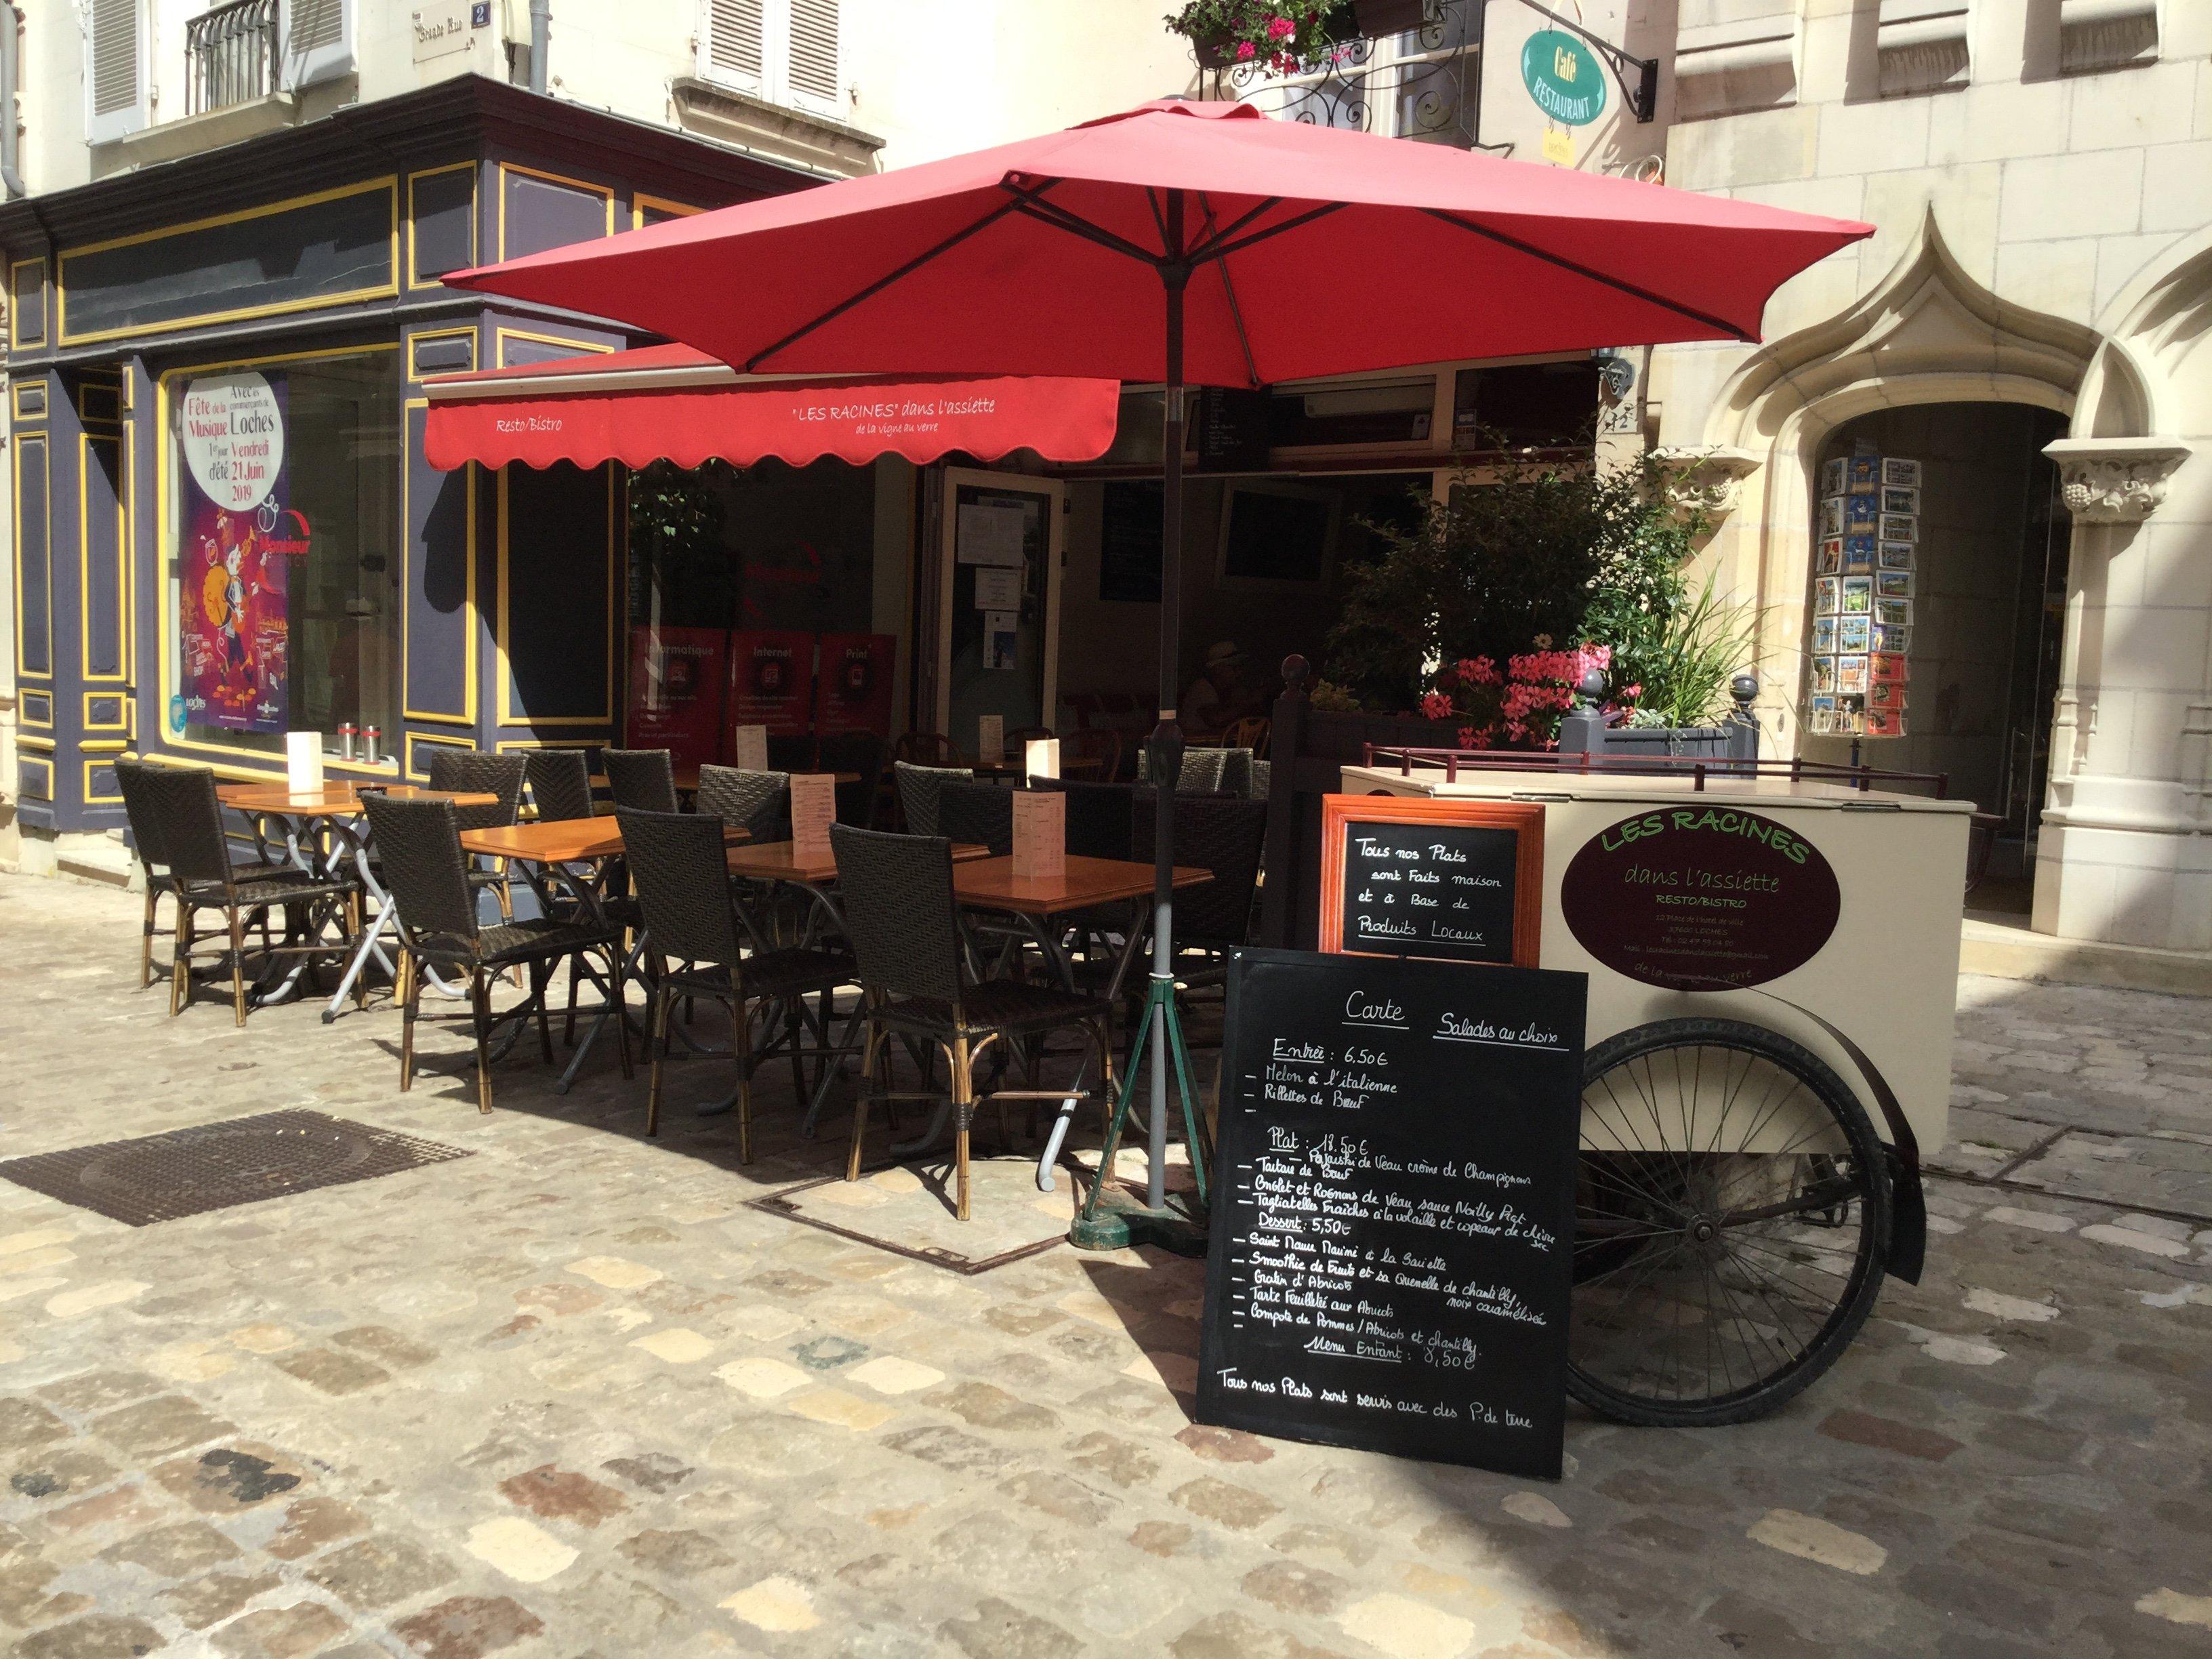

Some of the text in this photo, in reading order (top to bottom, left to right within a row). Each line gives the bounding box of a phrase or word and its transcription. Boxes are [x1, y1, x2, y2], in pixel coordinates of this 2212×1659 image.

[448, 16, 463, 33] Rue
[476, 5, 485, 23] 2
[1554, 45, 1576, 83] Café
[1533, 75, 1590, 120] RESTAURANT
[188, 396, 210, 416] Fête
[901, 399, 935, 416] dans
[939, 396, 996, 415] l'assiette
[188, 419, 228, 441] Musique
[230, 410, 274, 435] Loches
[496, 415, 562, 432] Resto/Bistro
[855, 422, 939, 437] de la vigne au verre
[231, 440, 269, 457] Vendredi
[209, 462, 228, 480] d'été
[232, 461, 264, 480] 21 Juin
[232, 484, 251, 501] 2019
[846, 648, 868, 659] Print
[1602, 810, 1810, 865] LES RACINES
[1355, 838, 1467, 863] Tous nos Plats
[1371, 869, 1502, 887] sont Faits maison
[1624, 863, 1780, 893] dans l'assiette
[1358, 888, 1469, 909] et à Base de
[1656, 895, 1747, 909] RESTO/BISTRO
[1357, 916, 1417, 935] Produits
[1347, 991, 1405, 1021] Carte
[1436, 1013, 1557, 1042] Salades au choix
[1266, 1063, 1397, 1093] Melon à l'italienne
[1265, 1084, 1307, 1103] Rillettes
[1310, 1092, 1323, 1105] de
[1299, 1164, 1313, 1176] de
[1357, 1156, 1371, 1168] de
[1375, 1155, 1402, 1171] Veau
[1408, 1159, 1437, 1173] crème
[1443, 1161, 1457, 1176] de
[1465, 1162, 1531, 1187] Champignons
[1296, 1182, 1311, 1194] et
[1361, 1189, 1379, 1204] de
[1386, 1192, 1412, 1208] Veau
[1417, 1199, 1450, 1213] sauce
[1252, 1192, 1318, 1213] Tagliatelles
[1373, 1209, 1381, 1220] à
[1384, 1207, 1393, 1221] la
[1396, 1208, 1436, 1227] volaille
[1440, 1216, 1455, 1229] et
[1457, 1224, 1501, 1237] copeaux
[1504, 1223, 1518, 1237] de
[1250, 1232, 1280, 1246] Saint
[1380, 1248, 1397, 1263] la
[1249, 1251, 1306, 1271] Smoothie
[1310, 1259, 1324, 1273] de
[1359, 1267, 1374, 1279] et
[1375, 1271, 1391, 1283] sa
[1395, 1273, 1439, 1290] Quenelle
[1443, 1281, 1457, 1294] de
[1254, 1269, 1287, 1286] Gratin
[1249, 1286, 1280, 1303] Tarte
[1331, 1301, 1352, 1311] aux
[1357, 1300, 1393, 1317] Abricots
[1446, 1296, 1471, 1309] noix
[1250, 1303, 1292, 1327] Compote
[1296, 1315, 1310, 1324] de
[1317, 1311, 1355, 1332] Pommes
[1412, 1330, 1423, 1344] et
[1303, 1336, 1345, 1353] Menu
[1217, 1368, 1248, 1389] Tous
[1251, 1380, 1275, 1393] nos
[1282, 1377, 1313, 1398] Plats
[1320, 1389, 1347, 1403] sont
[1357, 1393, 1393, 1409] servis
[1397, 1401, 1427, 1414] avec
[1433, 1401, 1457, 1418] des
